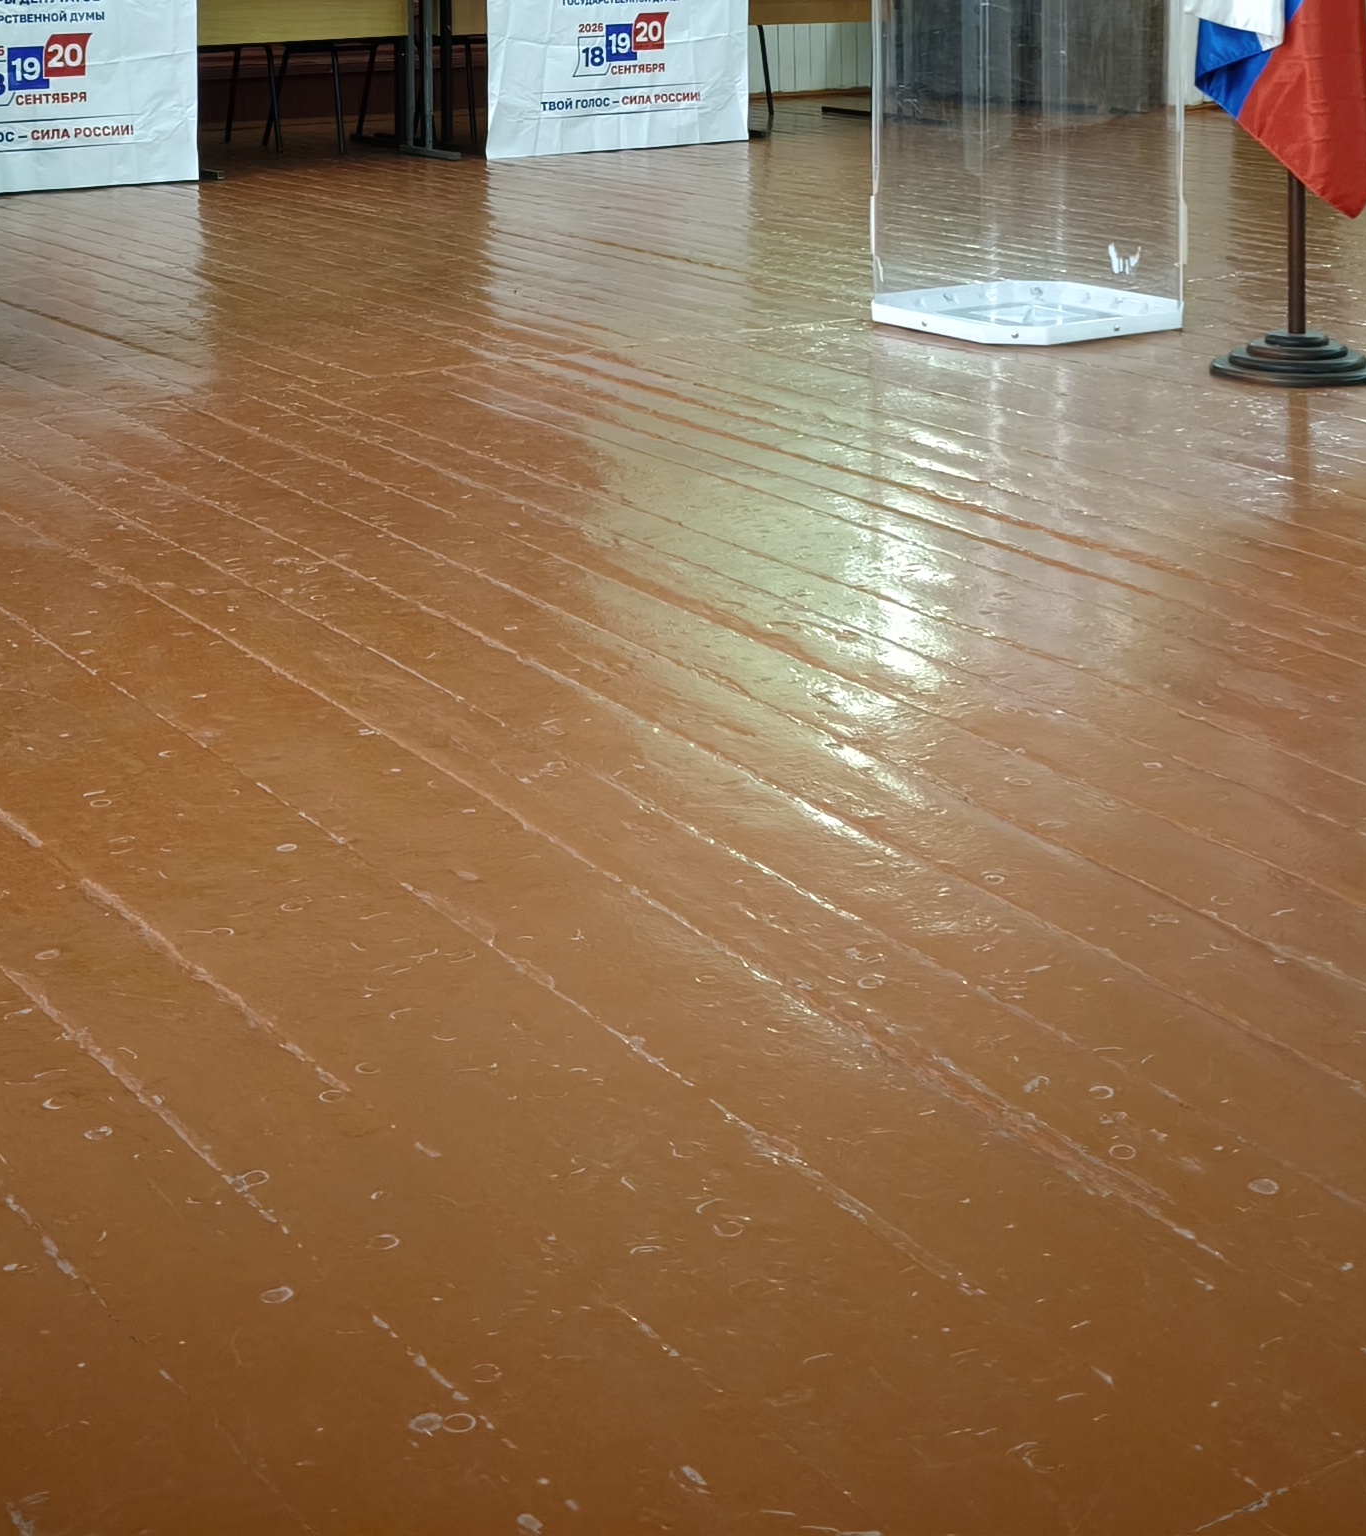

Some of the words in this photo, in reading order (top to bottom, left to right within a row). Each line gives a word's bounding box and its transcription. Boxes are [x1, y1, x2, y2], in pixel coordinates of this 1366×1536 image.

[69, 11, 105, 24] ДУМЫ
[578, 23, 604, 33] 2026
[581, 47, 604, 67] 18
[608, 32, 630, 54] 19
[635, 21, 662, 42] 20
[11, 57, 41, 82] 19
[47, 43, 83, 68] 20
[611, 63, 665, 75] СЕНТЯБРЯ
[15, 91, 87, 106] СЕНТЯБРЯ
[540, 98, 573, 111] ТВОЙ
[575, 97, 610, 109] ГОЛОС
[621, 94, 652, 106] СИЛА
[654, 92, 701, 103] РОССИИ!
[30, 127, 71, 141] СИЛА
[74, 124, 134, 138] РОССИИ!
